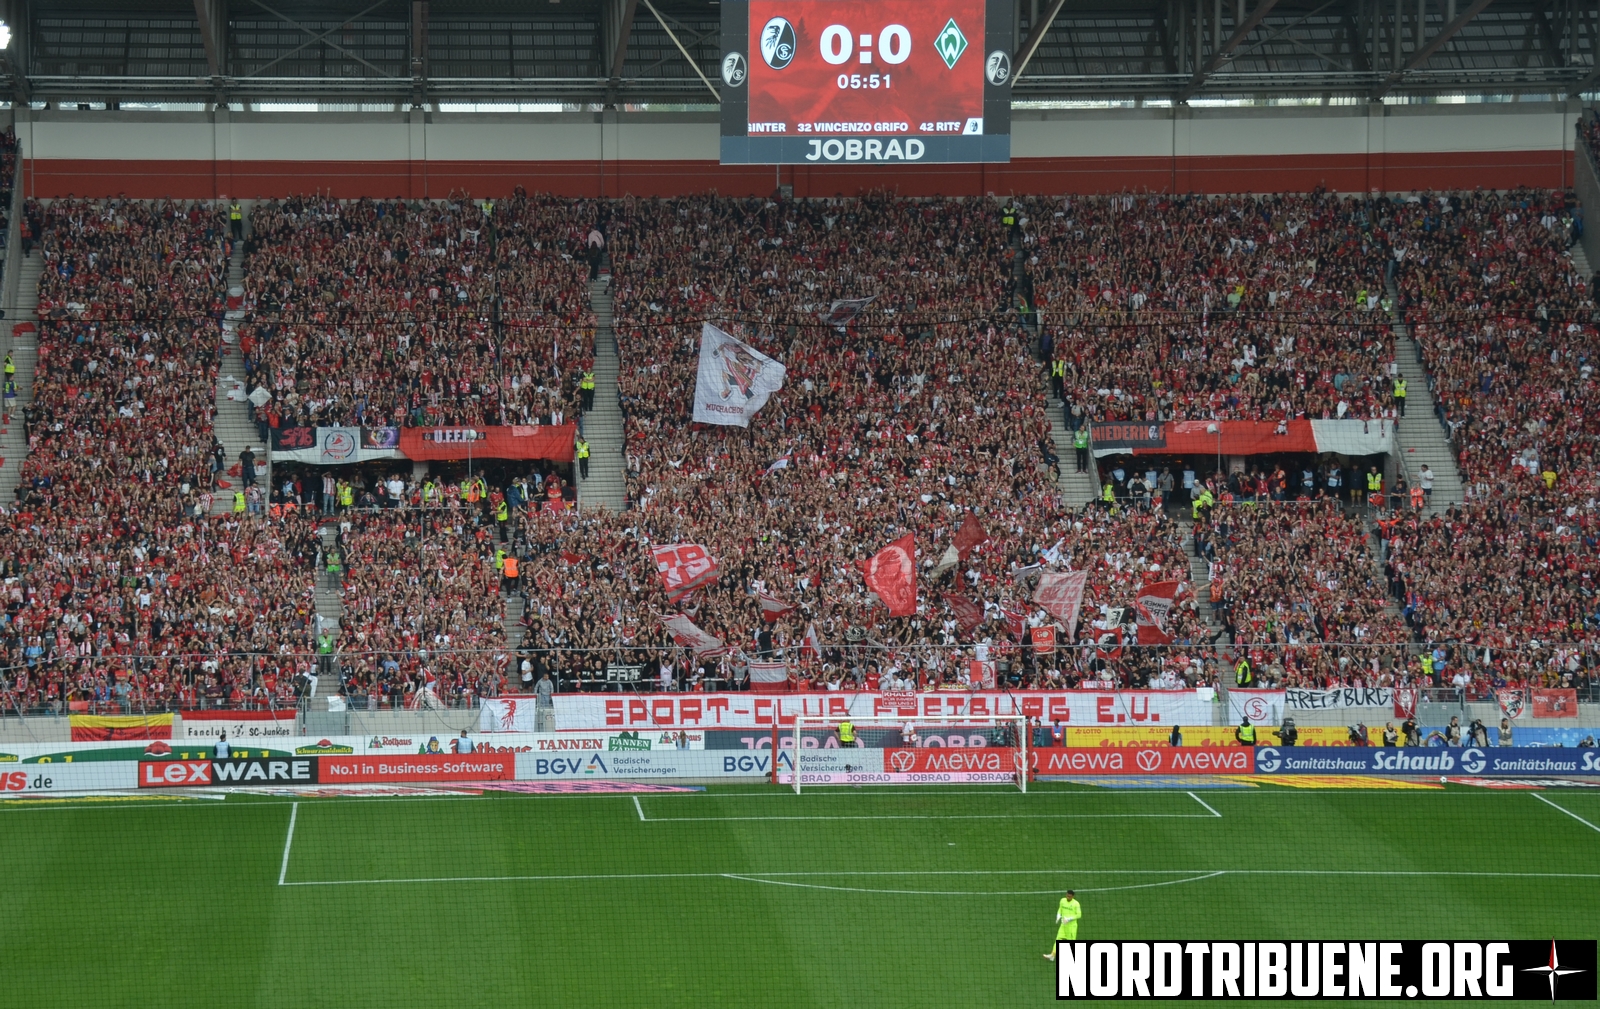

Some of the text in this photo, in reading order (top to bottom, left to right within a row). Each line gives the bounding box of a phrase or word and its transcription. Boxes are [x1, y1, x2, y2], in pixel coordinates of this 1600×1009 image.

[819, 24, 912, 65] 0:0
[837, 74, 891, 89] 05:51
[797, 122, 812, 132] 32
[813, 122, 872, 132] VINCENZO
[873, 122, 909, 132] GRIFO
[919, 122, 934, 132] 42
[805, 138, 925, 161] JOBRAD
[1344, 687, 1389, 707] BURG
[188, 727, 290, 737] Fanclub SC-Junkies
[382, 736, 412, 747] Rothaus
[537, 738, 603, 750] TANNEN
[610, 737, 650, 748] TANNEN
[613, 757, 650, 765] Badische
[724, 755, 769, 772] BGV
[800, 755, 837, 763] Badische
[1284, 750, 1455, 771] Sanitätshaus Schaub
[1493, 757, 1577, 771] Sanitätshaus
[330, 761, 504, 775] No.1 in Business-Software
[536, 758, 582, 775] BGV
[613, 766, 677, 775] Versicherungen
[846, 774, 891, 782] JOBRAD
[906, 773, 951, 782] JOBRAD
[966, 773, 1010, 781] JOBRAD
